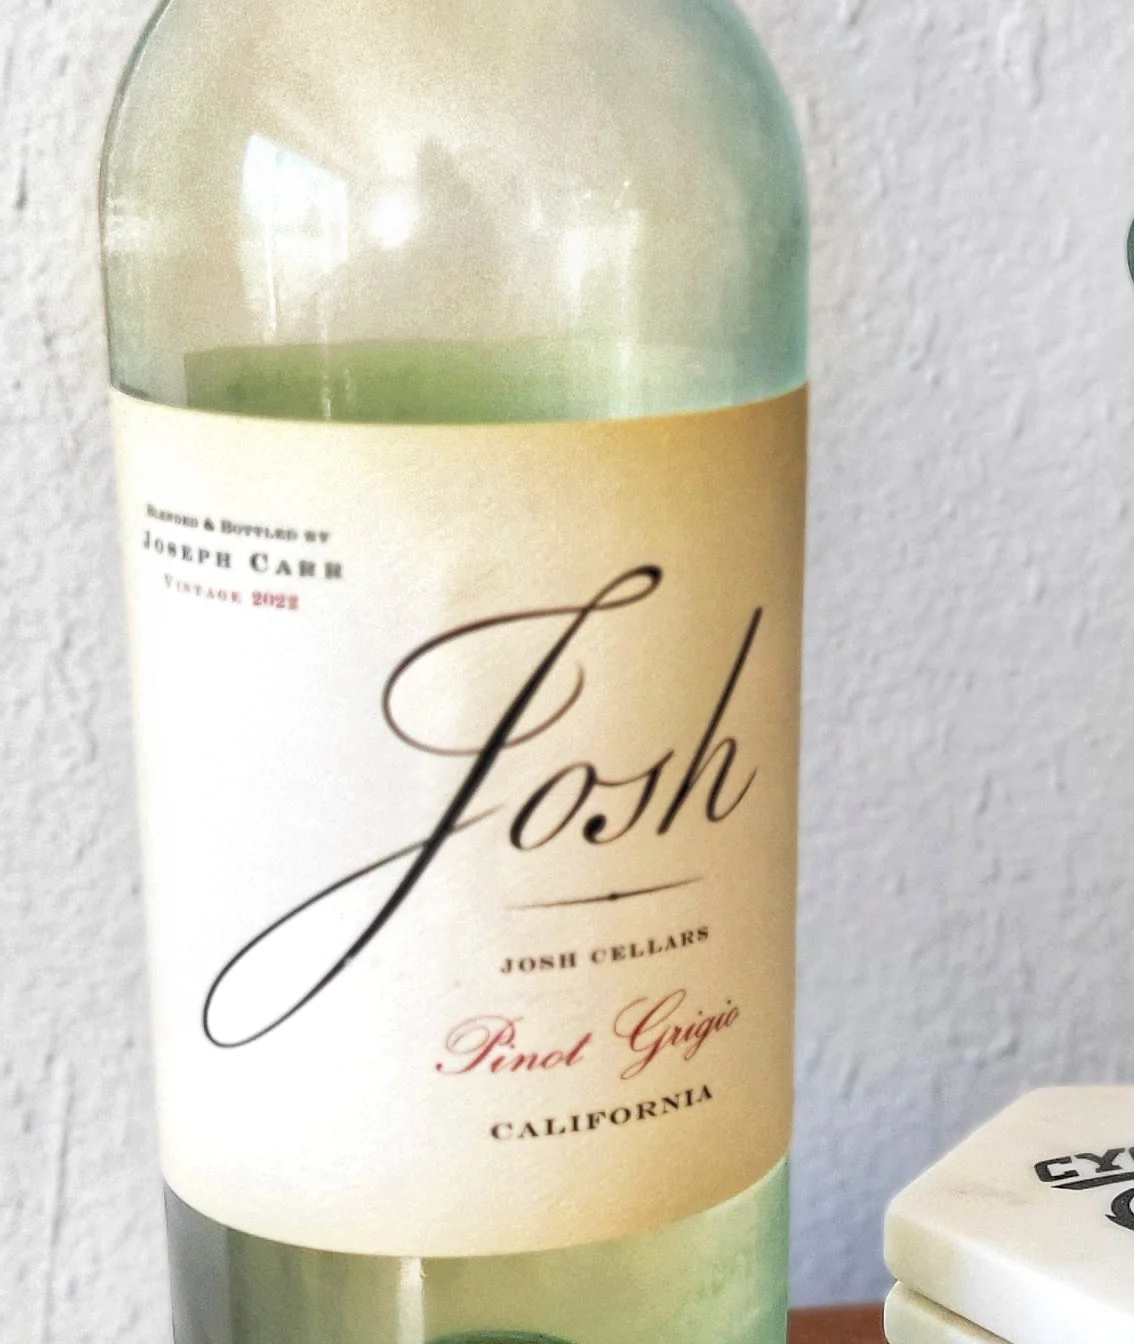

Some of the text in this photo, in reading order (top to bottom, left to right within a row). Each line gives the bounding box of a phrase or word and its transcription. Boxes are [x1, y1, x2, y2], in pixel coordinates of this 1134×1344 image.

[143, 530, 344, 580] JOSEPH CARR
[203, 518, 215, 532] &
[221, 519, 298, 542] BOTTLED
[164, 573, 242, 605] VINTAGE
[202, 564, 764, 1049] Josh
[500, 926, 711, 975] JOSH CELLARS
[435, 988, 741, 1081] Pinot Grigio
[490, 1084, 714, 1142] CALIFORNIA
